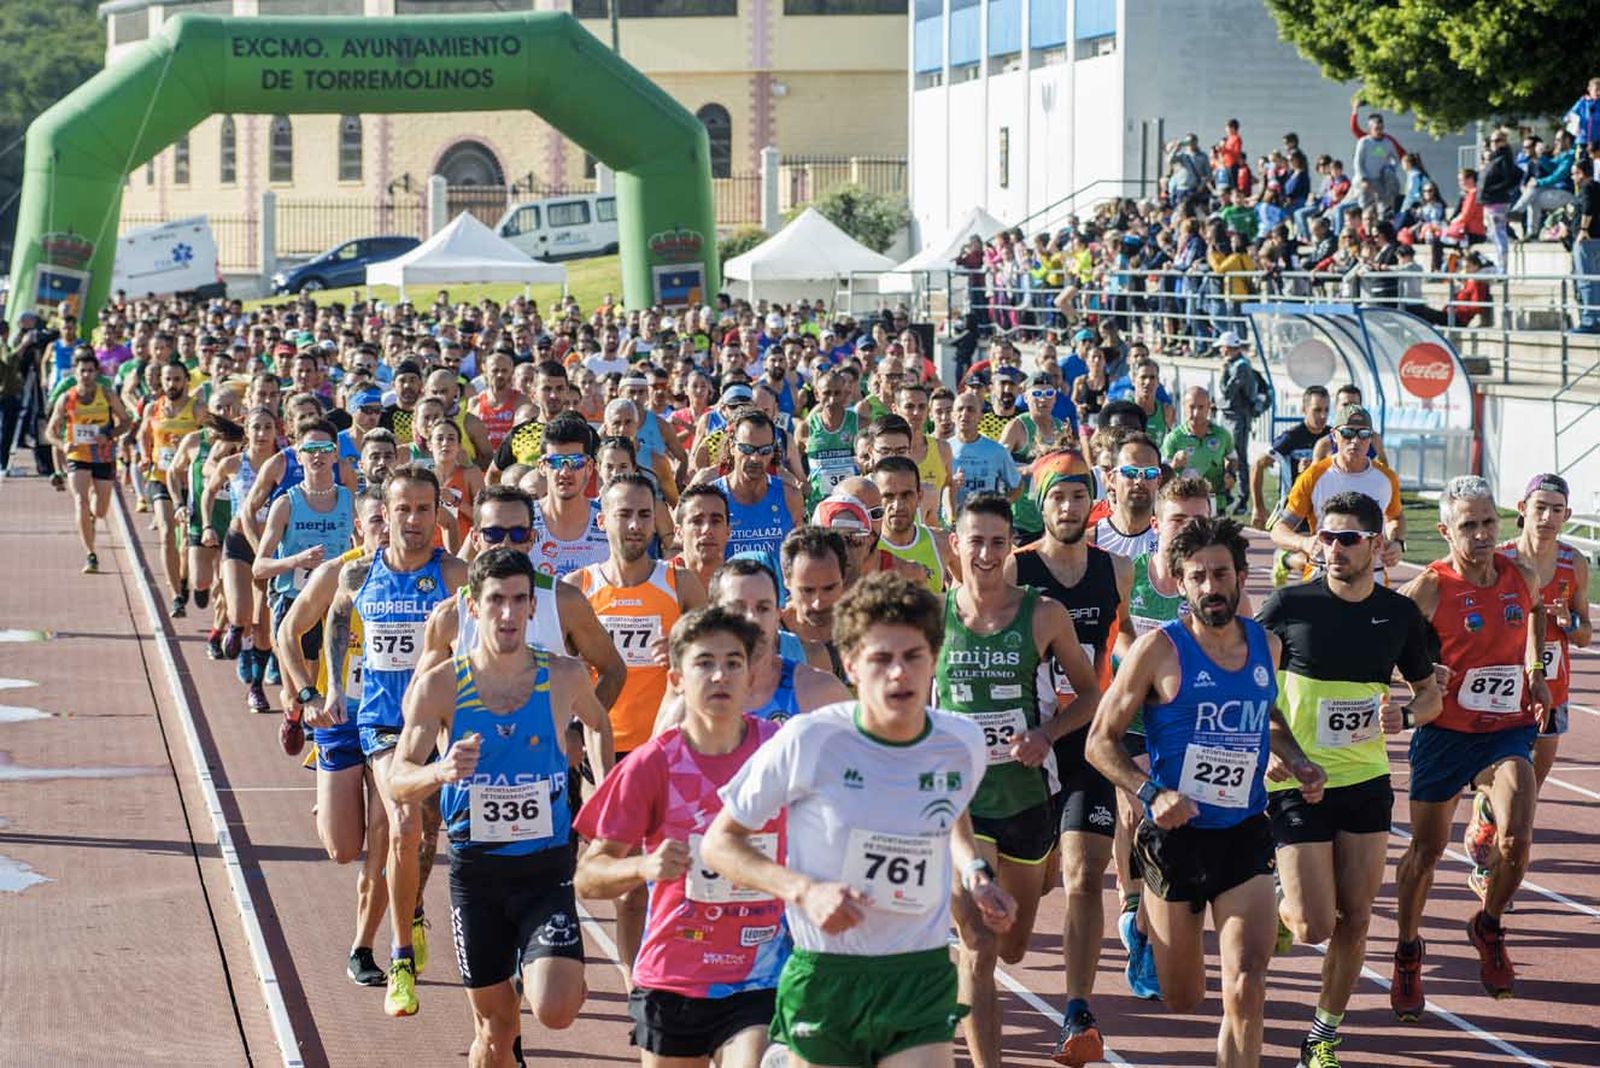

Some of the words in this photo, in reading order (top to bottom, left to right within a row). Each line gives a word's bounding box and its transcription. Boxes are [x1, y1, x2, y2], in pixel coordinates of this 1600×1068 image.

[232, 37, 329, 59] EXCMO.
[340, 35, 522, 58] AYUNTAMIENTO
[261, 69, 292, 91] DE
[303, 67, 495, 91] TORREMOLINOS
[295, 519, 336, 533] nerja
[373, 635, 415, 654] 575
[948, 646, 1020, 669] mijas
[951, 669, 1015, 679] ATLETISMO
[1470, 678, 1515, 696] 872
[1195, 700, 1268, 732] RCM
[1329, 709, 1374, 731] 637
[1193, 762, 1245, 787] 223
[483, 799, 539, 822] 336
[864, 852, 927, 887] 761
